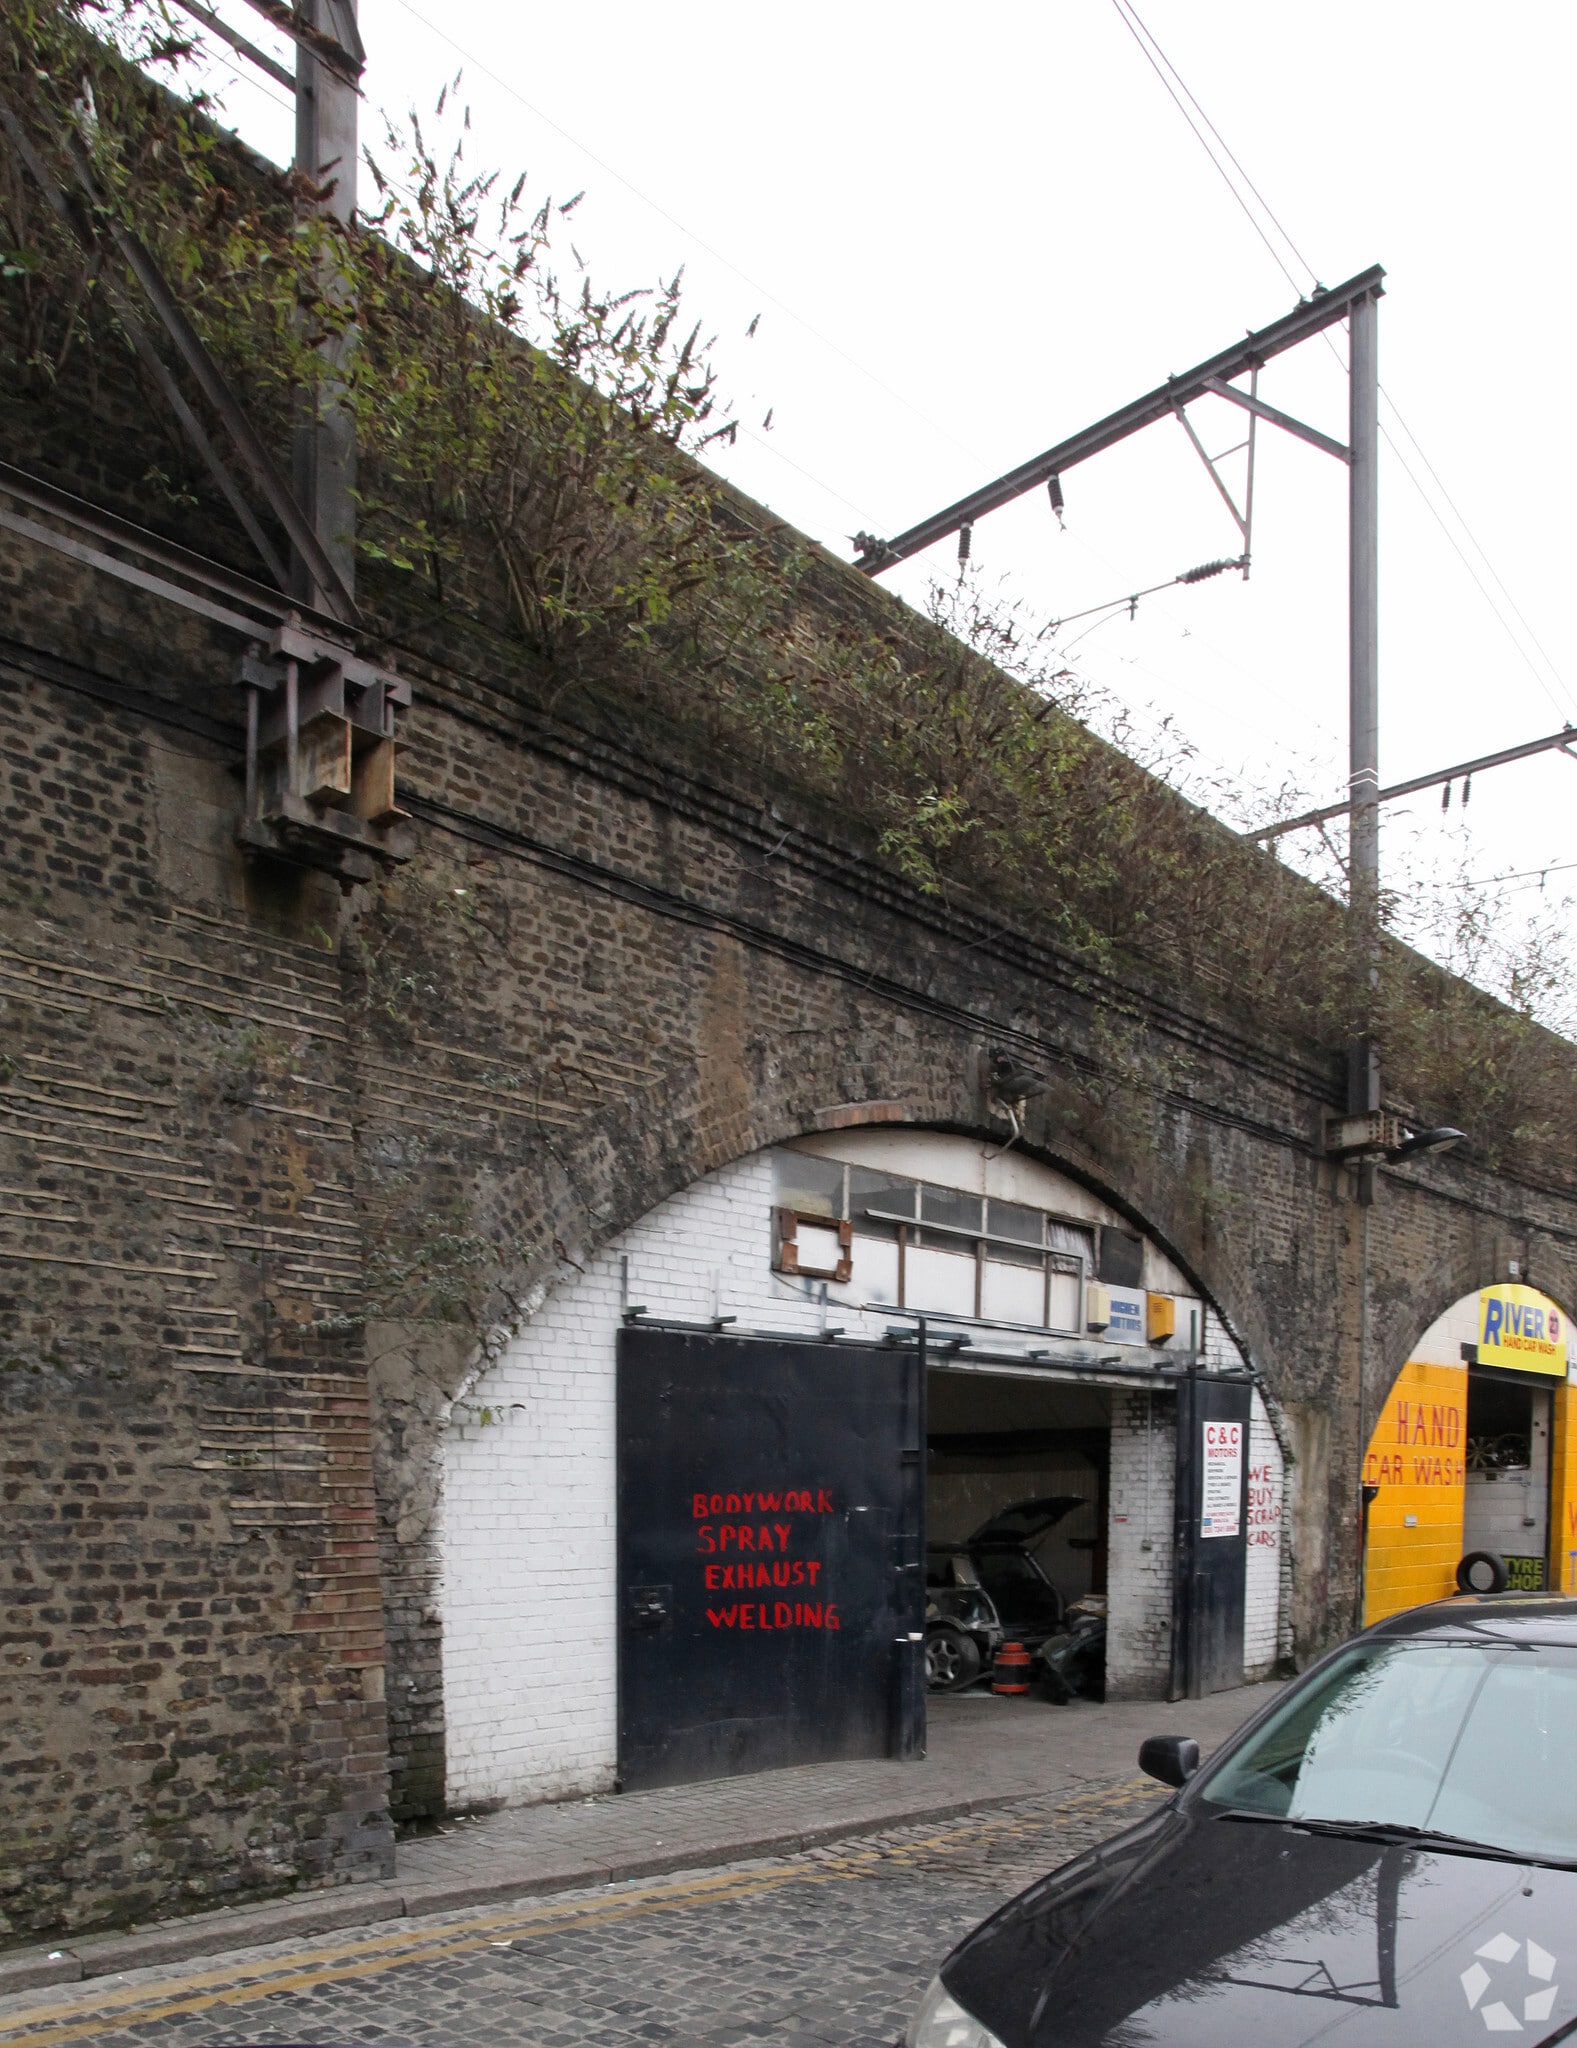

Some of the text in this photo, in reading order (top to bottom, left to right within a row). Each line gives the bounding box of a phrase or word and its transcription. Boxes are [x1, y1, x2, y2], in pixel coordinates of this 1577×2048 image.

[1484, 1298, 1545, 1346] RIVER
[1503, 1335, 1557, 1356] HAND CAR WASH
[1398, 1401, 1460, 1448] HAND
[1207, 1427, 1239, 1444] C & C
[1208, 1448, 1238, 1457] MOTORS
[1248, 1465, 1272, 1482] WE
[1368, 1454, 1464, 1486] CAR WASH
[693, 1489, 833, 1518] BODYWORK
[1248, 1486, 1275, 1506] BUY
[1247, 1505, 1281, 1526] SCRAP
[697, 1523, 792, 1553] SPRAY
[1247, 1530, 1276, 1547] CARS
[705, 1561, 821, 1590] EXHAUST
[1504, 1557, 1544, 1574] TYRE
[706, 1602, 840, 1630] WELDING
